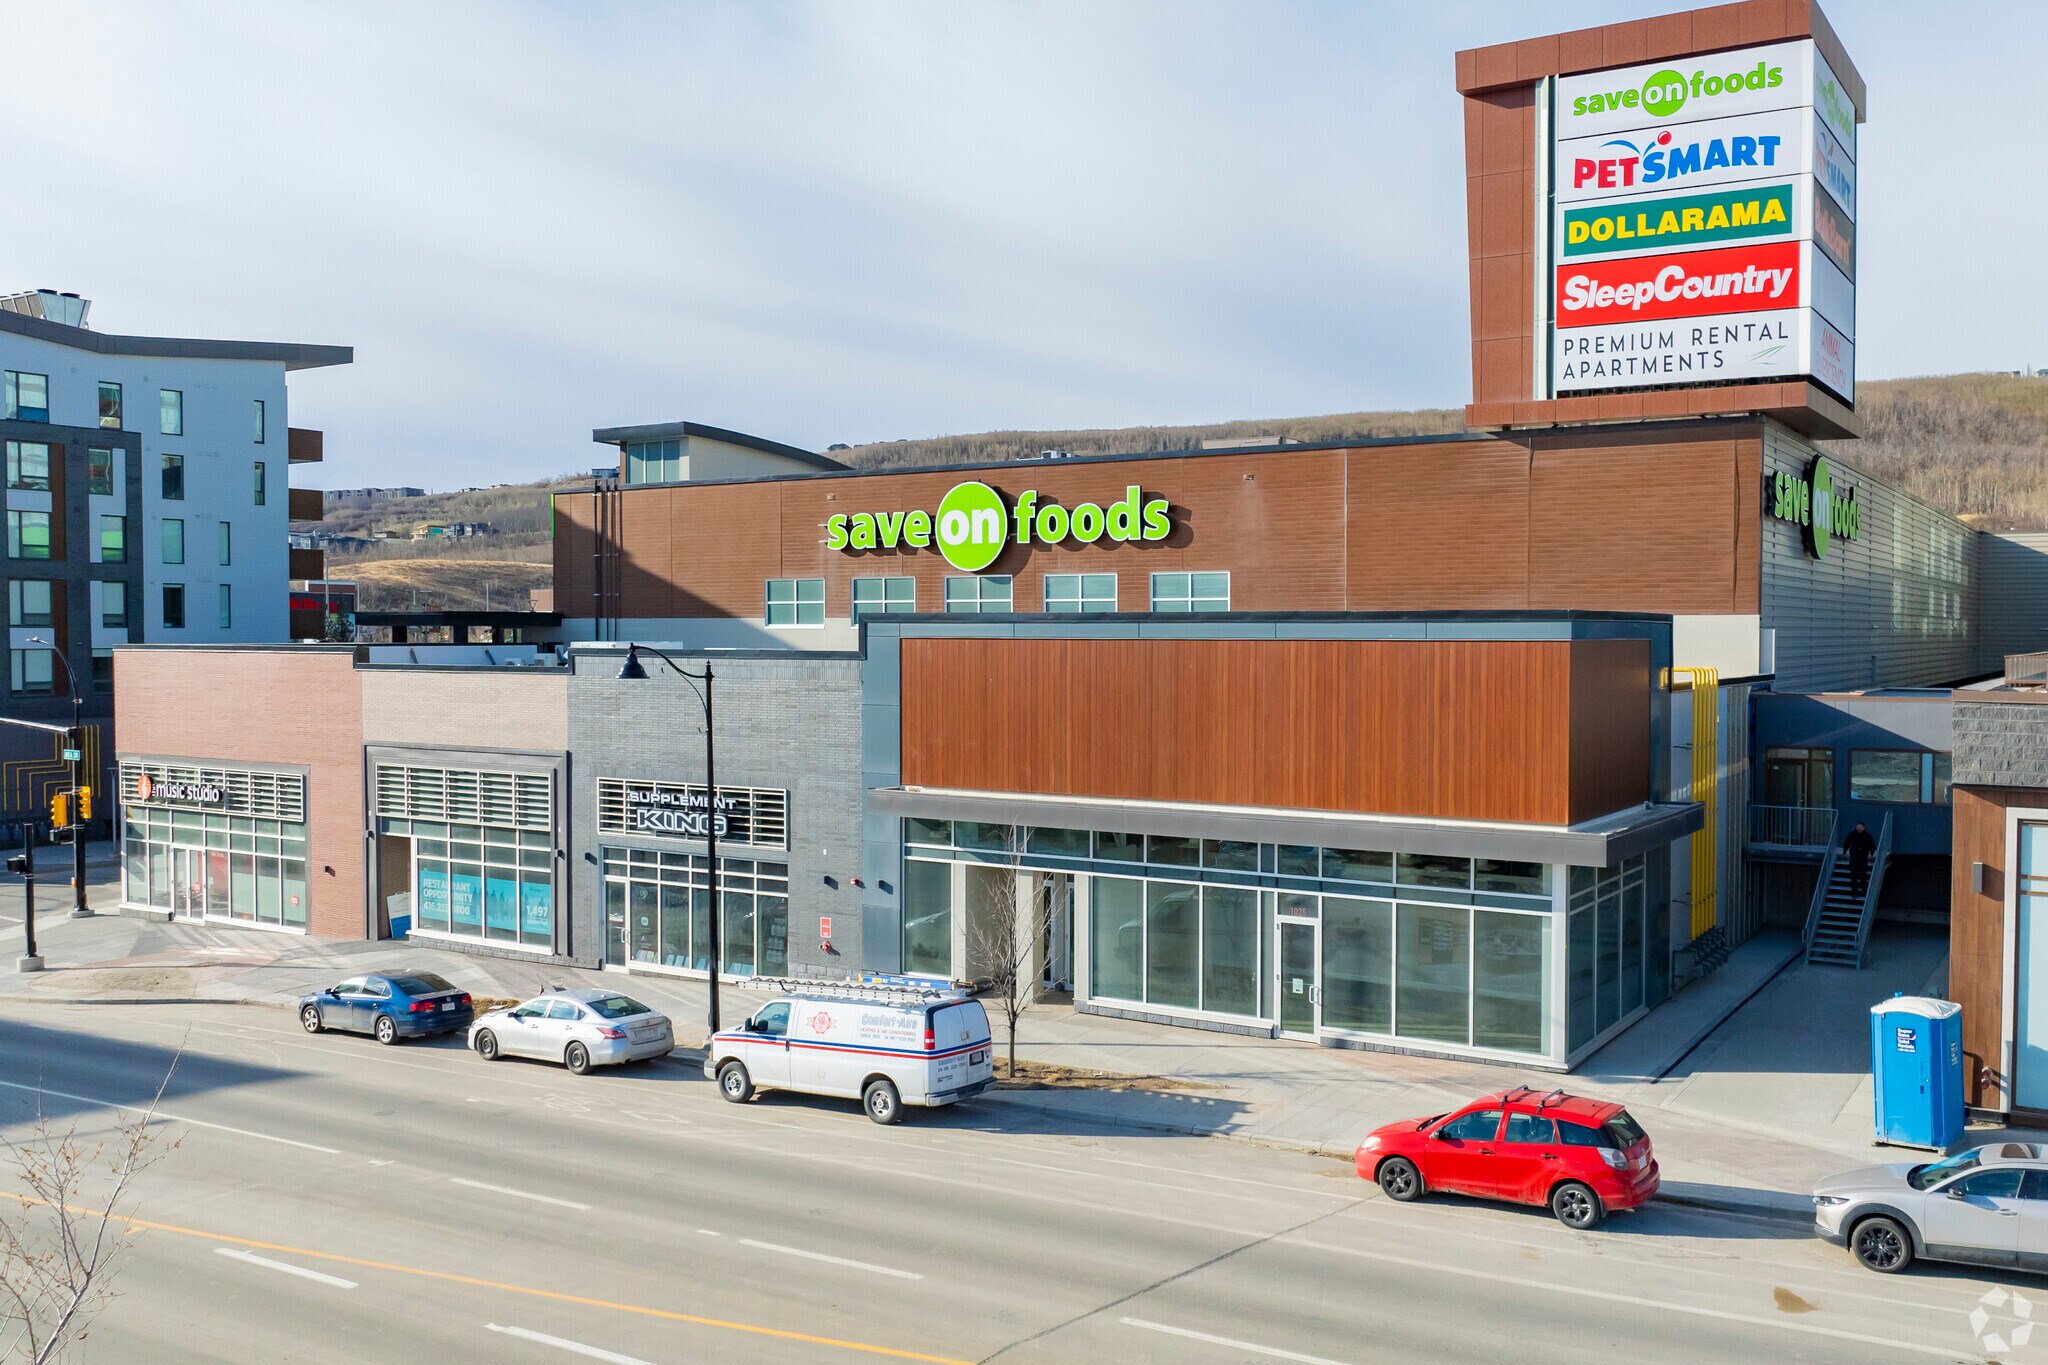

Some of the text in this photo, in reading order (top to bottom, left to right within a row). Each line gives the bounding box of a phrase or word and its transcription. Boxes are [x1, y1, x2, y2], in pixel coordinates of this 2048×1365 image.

[1573, 62, 1784, 116] save on foods
[1573, 135, 1781, 189] PETSMART
[1568, 198, 1786, 244] DOLLARAMA
[1564, 321, 1788, 355] PREMIUM RENTAL
[1821, 327, 1841, 362] ANIMAL
[1563, 350, 1724, 379] APARTMENTS
[827, 485, 1171, 550] save on foods
[1774, 470, 1861, 541] save on foods
[157, 783, 185, 799] music
[187, 784, 220, 802] studio
[629, 791, 736, 809] SUPPLEMENT
[636, 807, 728, 837] KING
[423, 888, 473, 903] OPPORUNITY
[526, 905, 548, 917] 1,497
[1289, 907, 1307, 916] 1025
